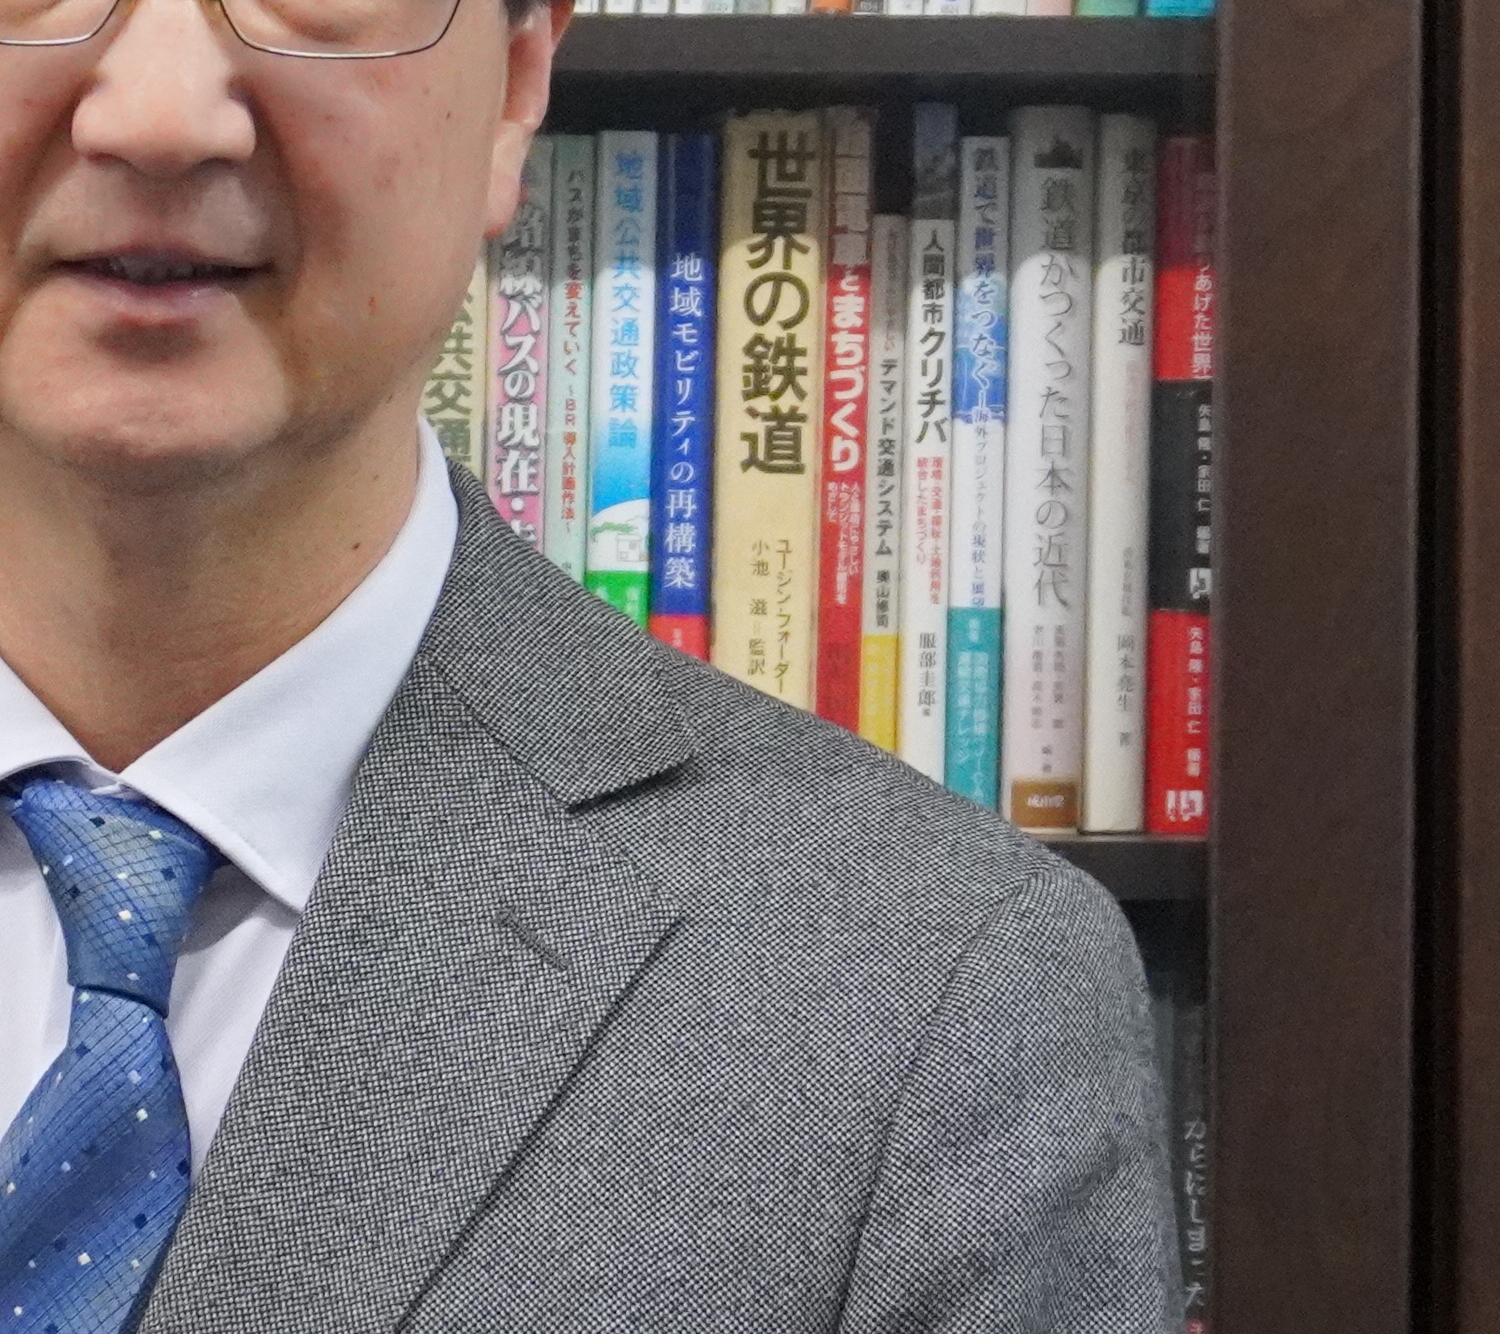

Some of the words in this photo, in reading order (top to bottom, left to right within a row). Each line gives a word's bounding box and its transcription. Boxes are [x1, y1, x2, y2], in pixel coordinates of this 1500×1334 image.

[608, 152, 643, 449] 地域公共交通政策論
[664, 252, 705, 590] 地域モビリティの再構築
[740, 131, 816, 477] 世界の鉄道
[915, 229, 946, 445] 人間都市クリチバ
[1033, 179, 1082, 608] 鉄道がつくった日本の近代
